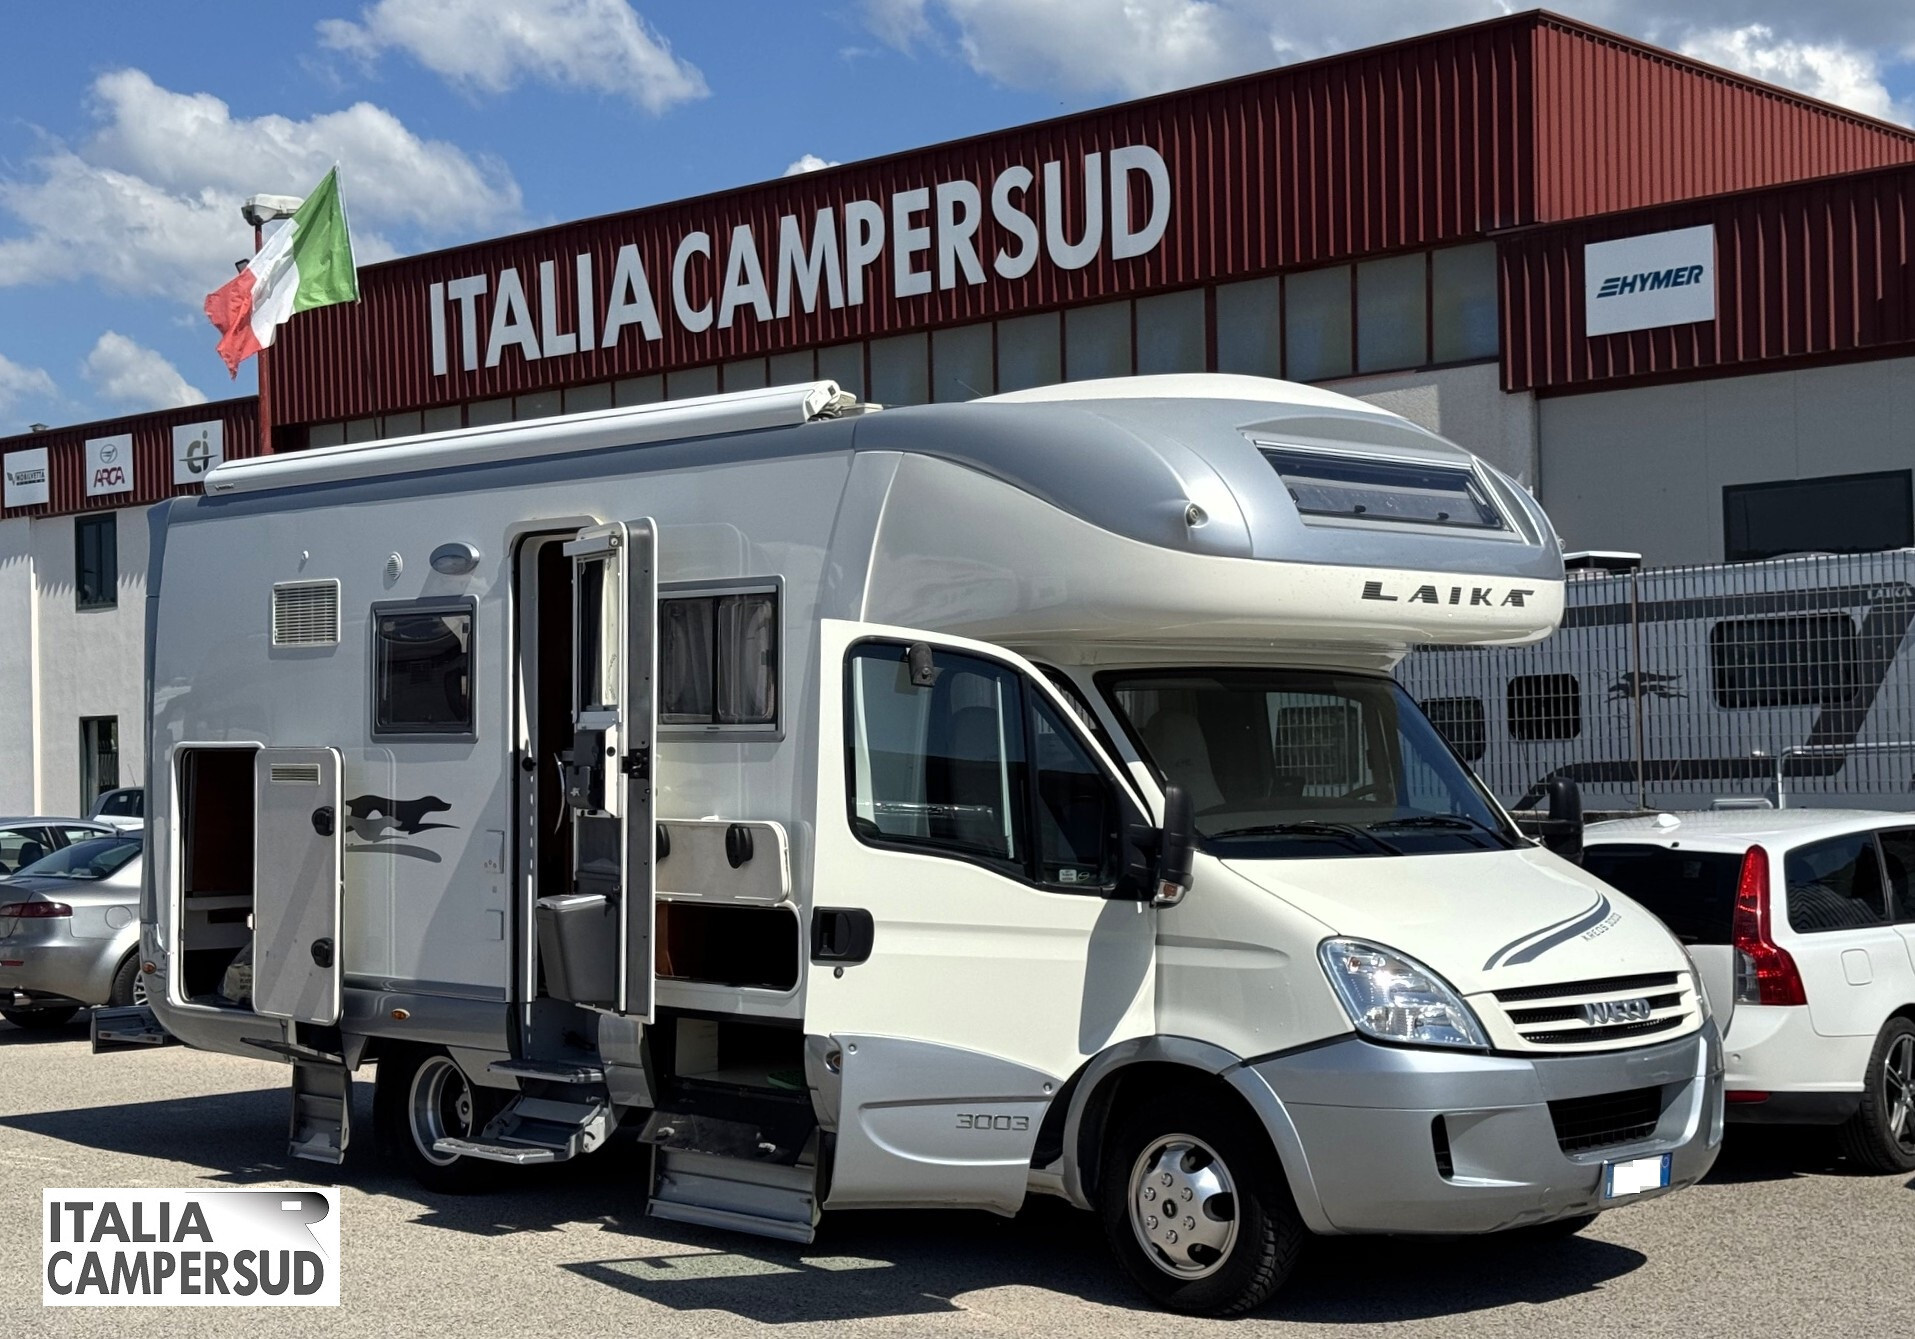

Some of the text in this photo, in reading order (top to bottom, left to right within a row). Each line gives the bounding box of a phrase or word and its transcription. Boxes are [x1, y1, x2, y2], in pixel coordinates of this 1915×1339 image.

[430, 145, 1172, 376] ITALIA CAMPERSUD
[1617, 264, 1704, 296] HYMER
[93, 466, 125, 488] ARCA
[1361, 580, 1535, 607] LAIKA
[1584, 998, 1651, 1026] IVECO
[955, 1113, 1030, 1131] 3003
